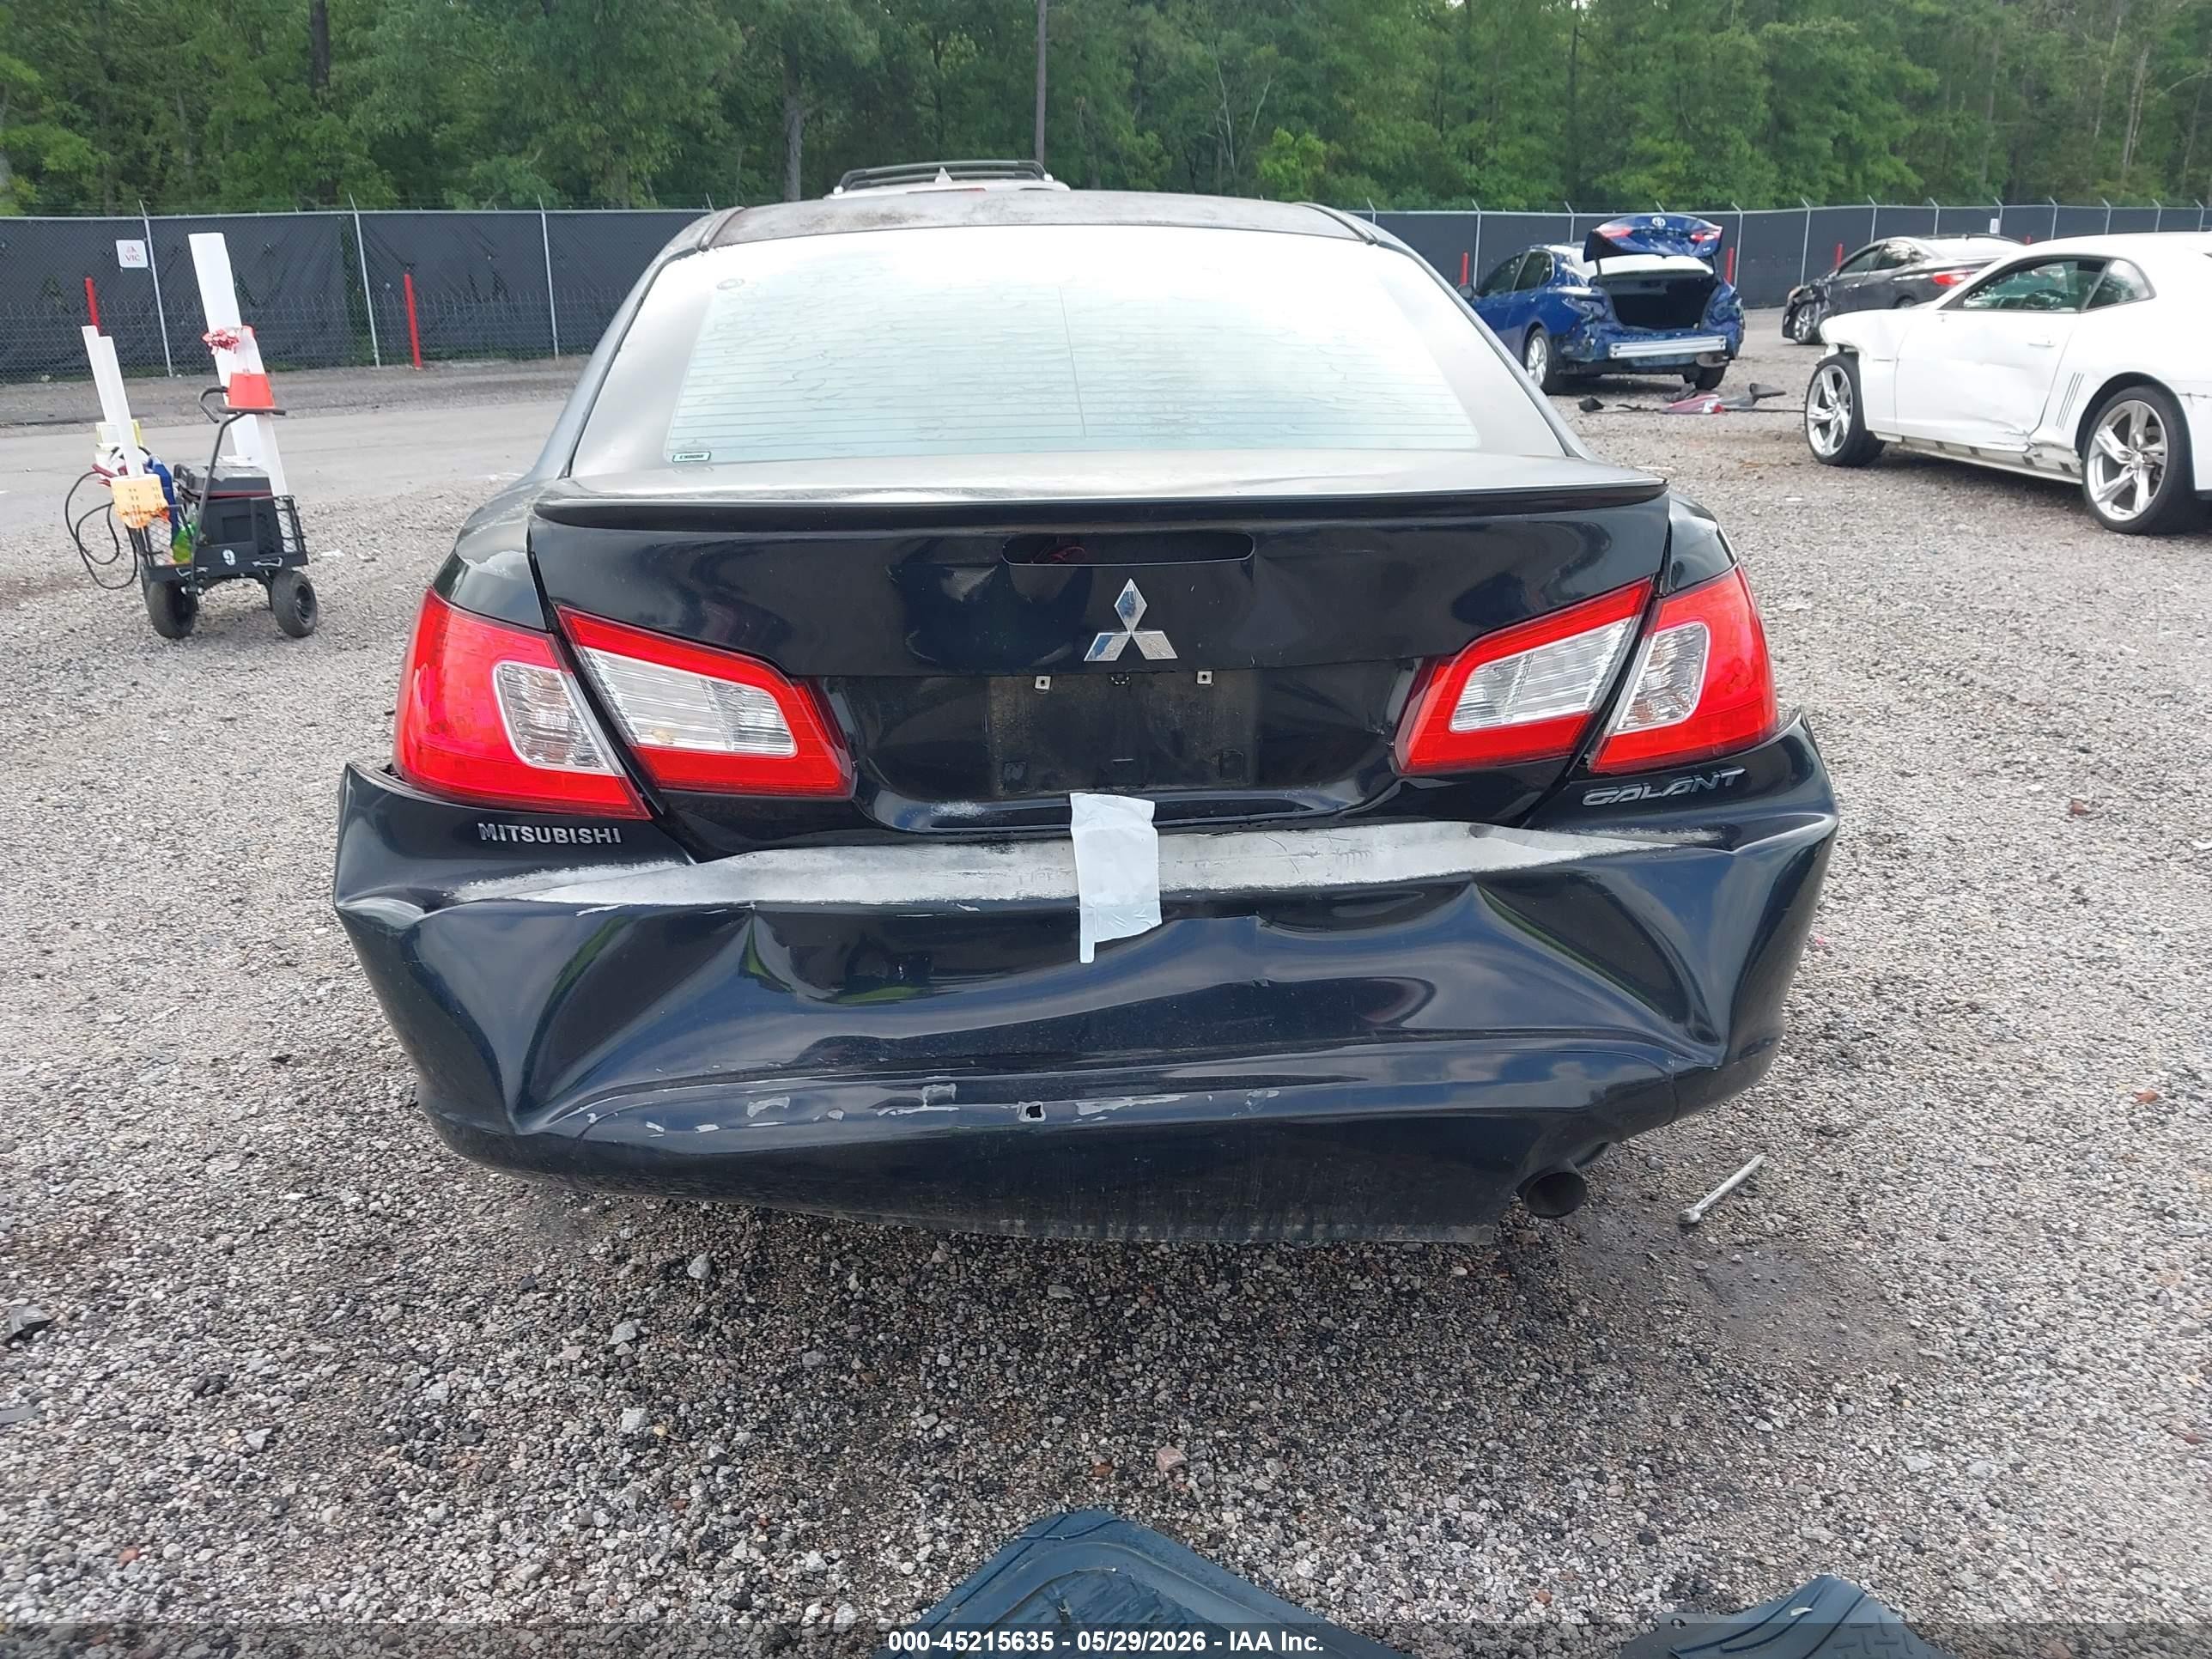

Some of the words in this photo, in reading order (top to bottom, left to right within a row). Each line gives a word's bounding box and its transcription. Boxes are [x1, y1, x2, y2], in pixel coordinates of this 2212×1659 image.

[125, 253, 141, 262] VIC
[222, 549, 236, 566] 9
[1582, 766, 1747, 806] GALANT
[477, 822, 623, 844] MITSUBISHI
